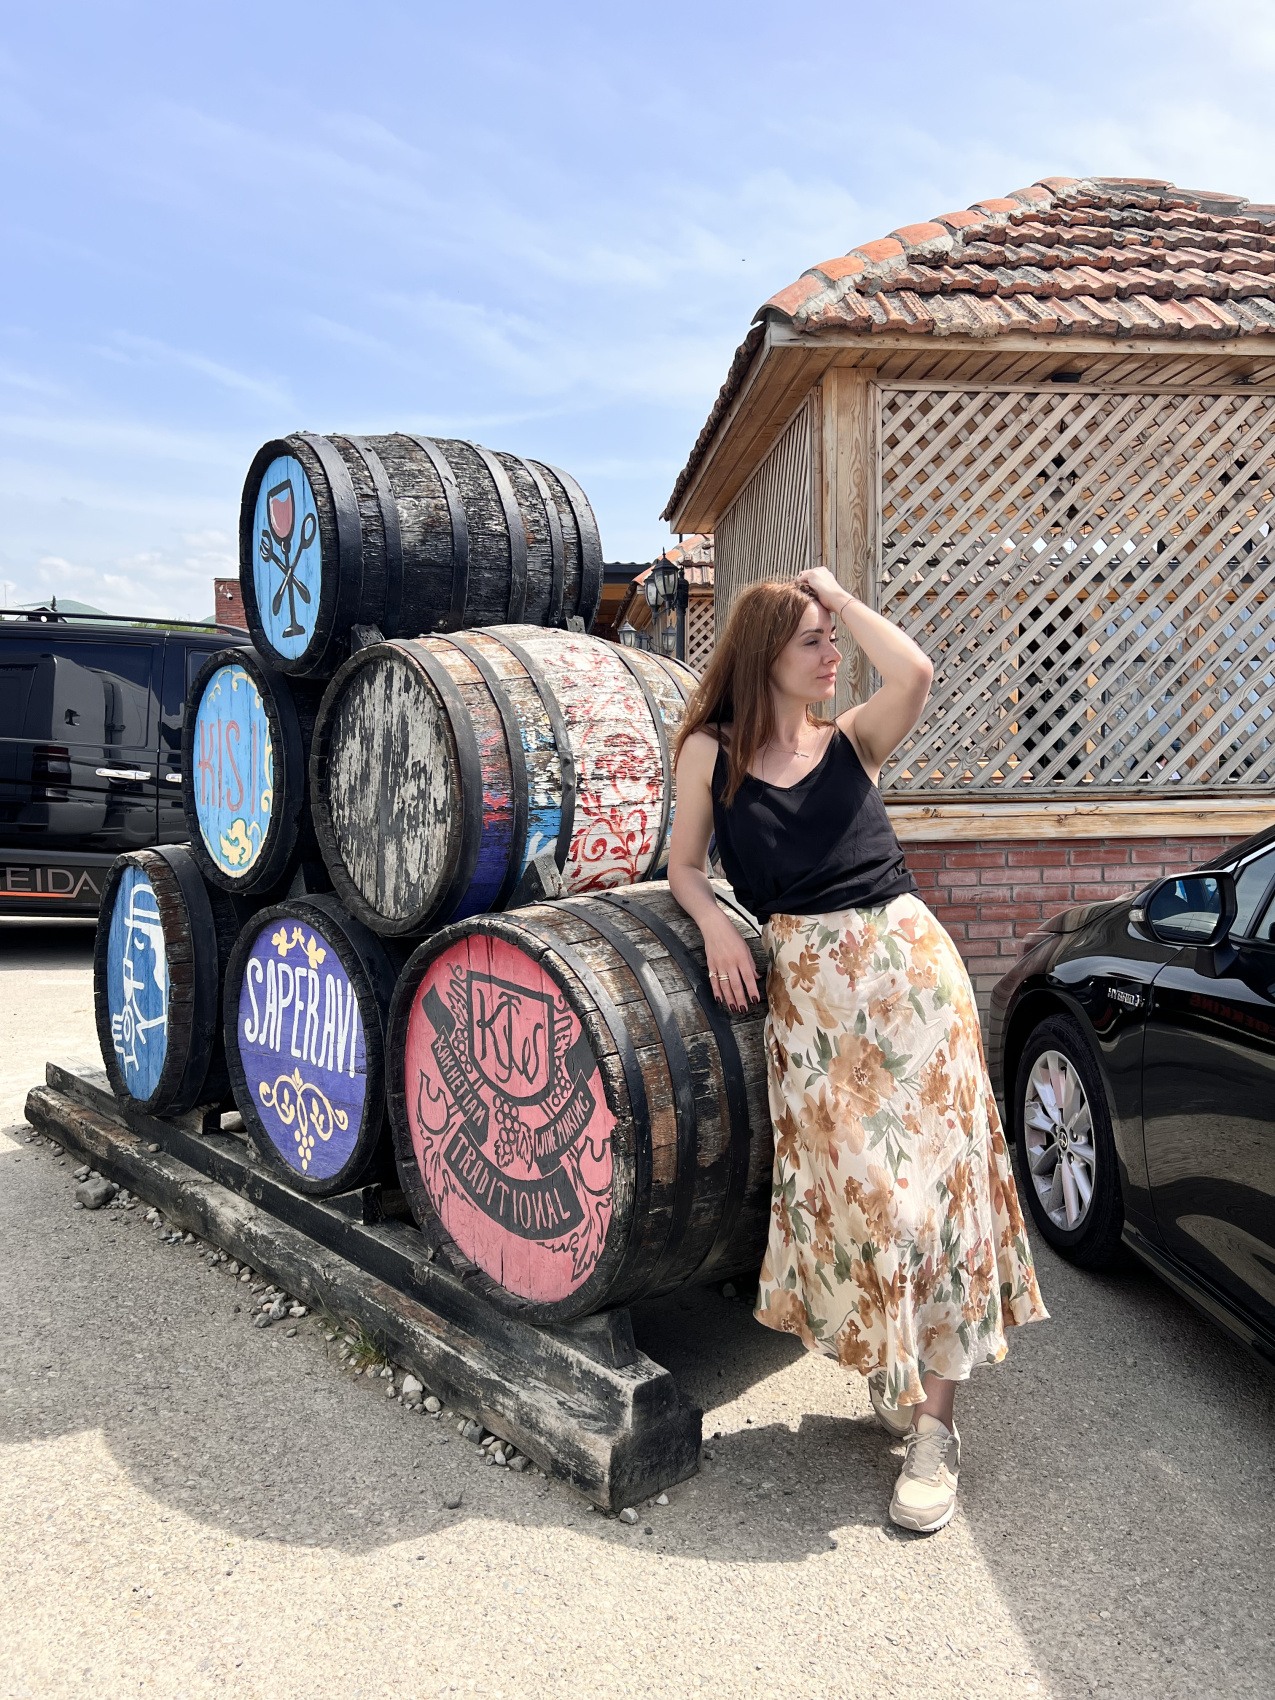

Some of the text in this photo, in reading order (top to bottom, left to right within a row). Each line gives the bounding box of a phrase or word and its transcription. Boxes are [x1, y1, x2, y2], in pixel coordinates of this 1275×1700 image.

[198, 719, 257, 815] KISI
[0, 867, 100, 898] EIDA
[244, 957, 359, 1079] SAPERAVI
[434, 1034, 486, 1127] KAKHETIAN
[450, 1132, 571, 1230] TRADITIONAL
[535, 1126, 558, 1158] WINE
